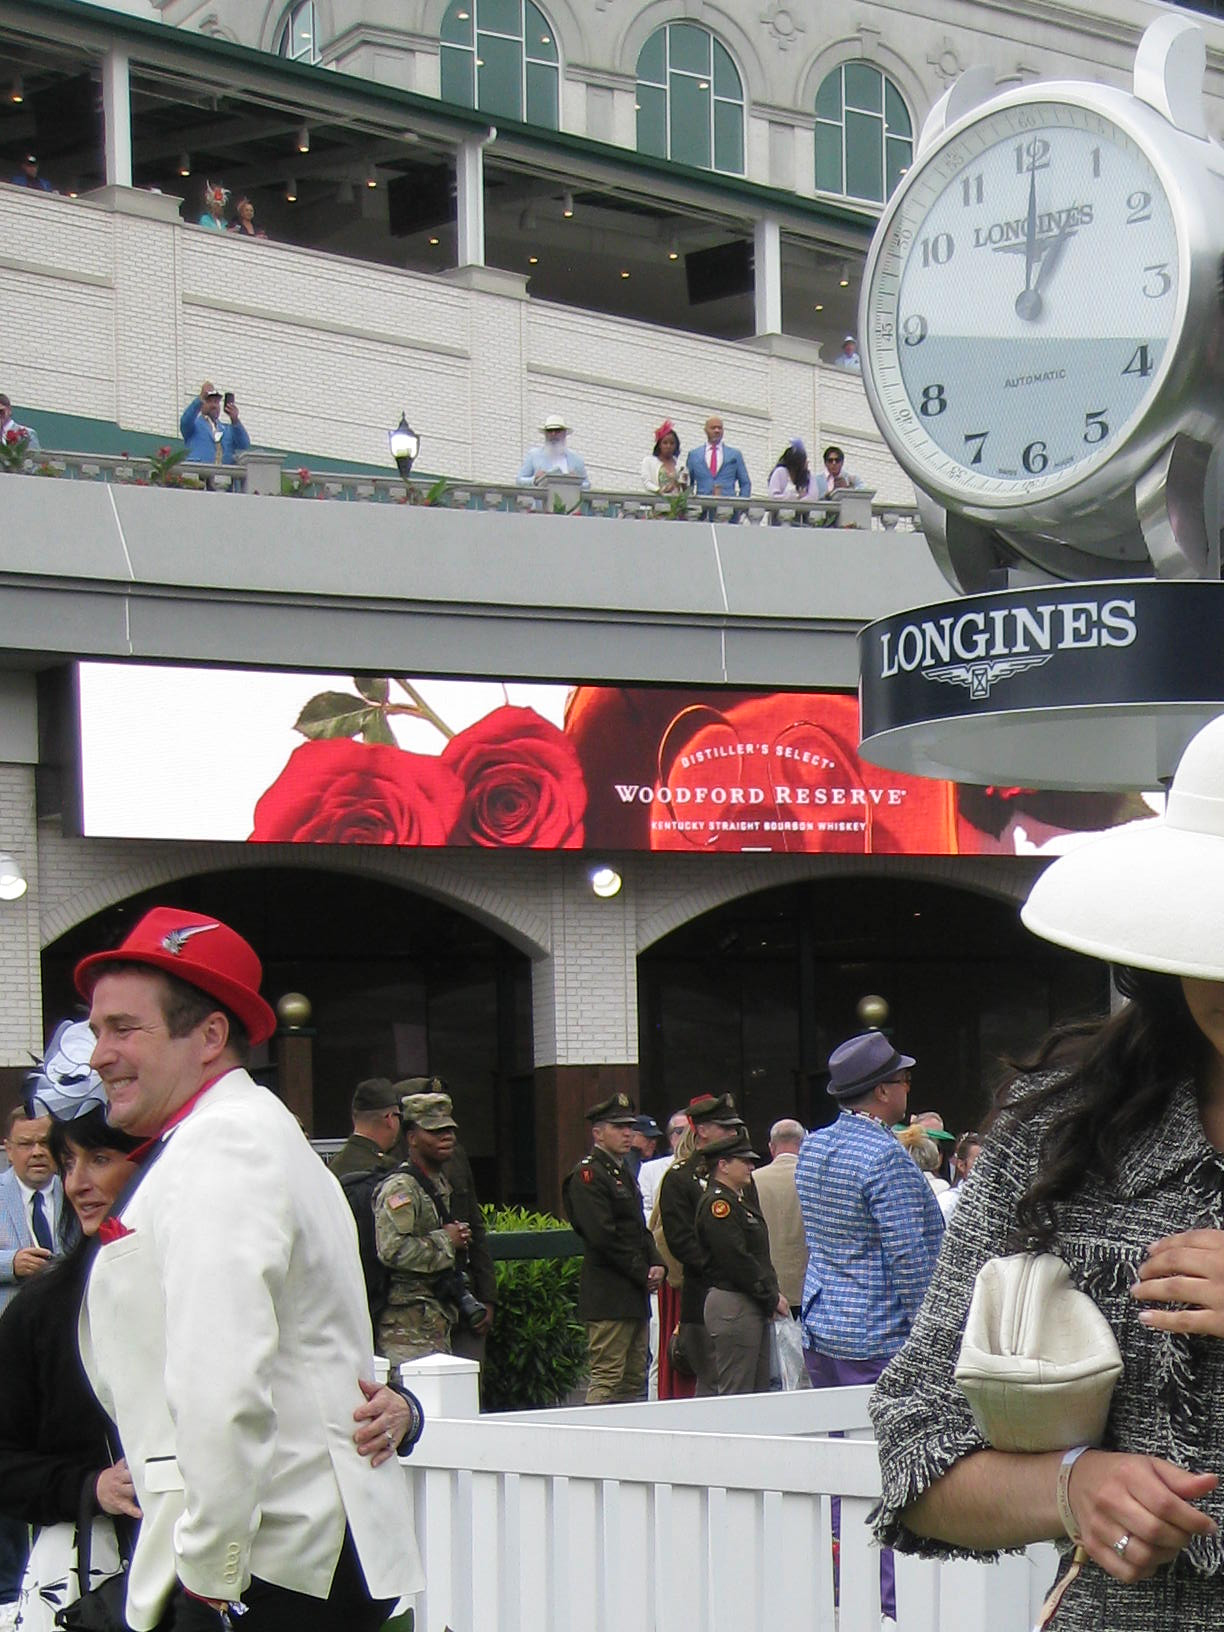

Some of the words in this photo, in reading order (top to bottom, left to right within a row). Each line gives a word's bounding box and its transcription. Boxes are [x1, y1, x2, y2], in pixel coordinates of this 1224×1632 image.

[1014, 138, 1051, 174] 12
[1090, 146, 1101, 178] 1
[962, 174, 984, 207] 11
[1126, 190, 1152, 224] 2
[921, 232, 955, 268] 10
[1142, 263, 1171, 299] 3
[903, 313, 928, 346] 9
[1121, 343, 1154, 377] 4
[1004, 368, 1066, 388] AUTOMATIC
[920, 383, 947, 417] 8
[1083, 407, 1109, 443] 5
[964, 431, 990, 465] 7
[1022, 440, 1049, 474] 6
[880, 599, 1138, 679] LONGINES
[681, 743, 769, 768] DISTILLER'S
[614, 784, 765, 804] WOODFORD
[775, 786, 903, 805] RESERVE
[651, 820, 705, 832] KENTUCKY
[708, 820, 760, 832] STRAIGHT
[763, 820, 814, 832] BOURBON
[818, 820, 867, 833] WHISKEY
